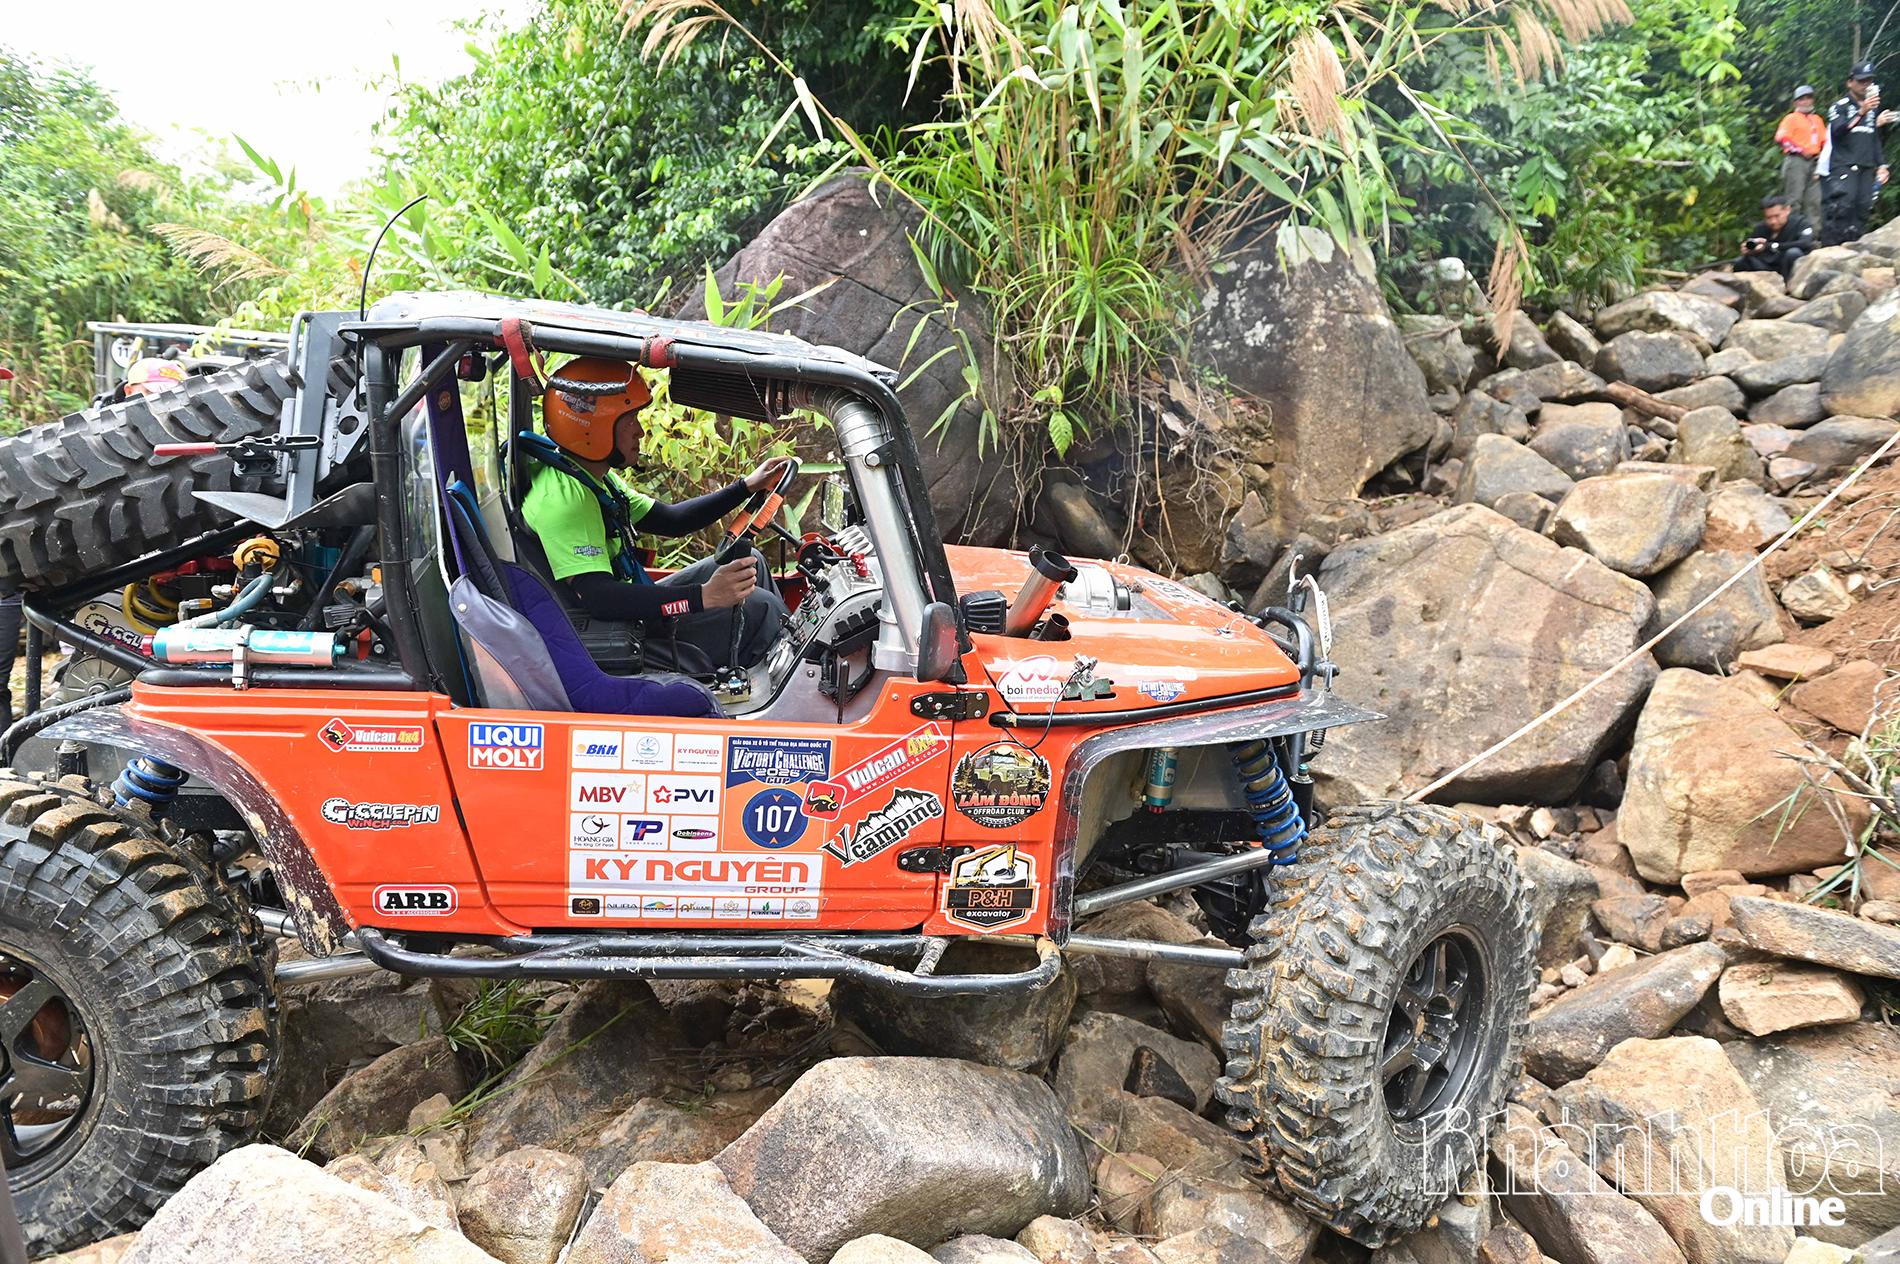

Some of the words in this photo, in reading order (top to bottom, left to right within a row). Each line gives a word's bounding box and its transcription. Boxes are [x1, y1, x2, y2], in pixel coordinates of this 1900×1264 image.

[1006, 684, 1023, 694] boi
[1026, 685, 1059, 694] media
[354, 729, 397, 743] Vulcan
[397, 731, 420, 743] 4x4
[473, 725, 539, 747] LIQUI
[473, 747, 541, 768] MOLY
[844, 747, 909, 791] Vulcan
[906, 727, 939, 757] 4x4
[755, 767, 800, 777] 2026
[766, 777, 790, 785] CUP
[579, 786, 627, 803] MBV
[674, 789, 714, 803] PVI
[959, 791, 996, 807] LÂM
[755, 805, 798, 833] 107
[626, 820, 664, 841] TP
[744, 886, 807, 894] GROUP
[384, 892, 449, 909] ARB
[968, 889, 1013, 908] P&H
[966, 910, 1011, 919] excavator
